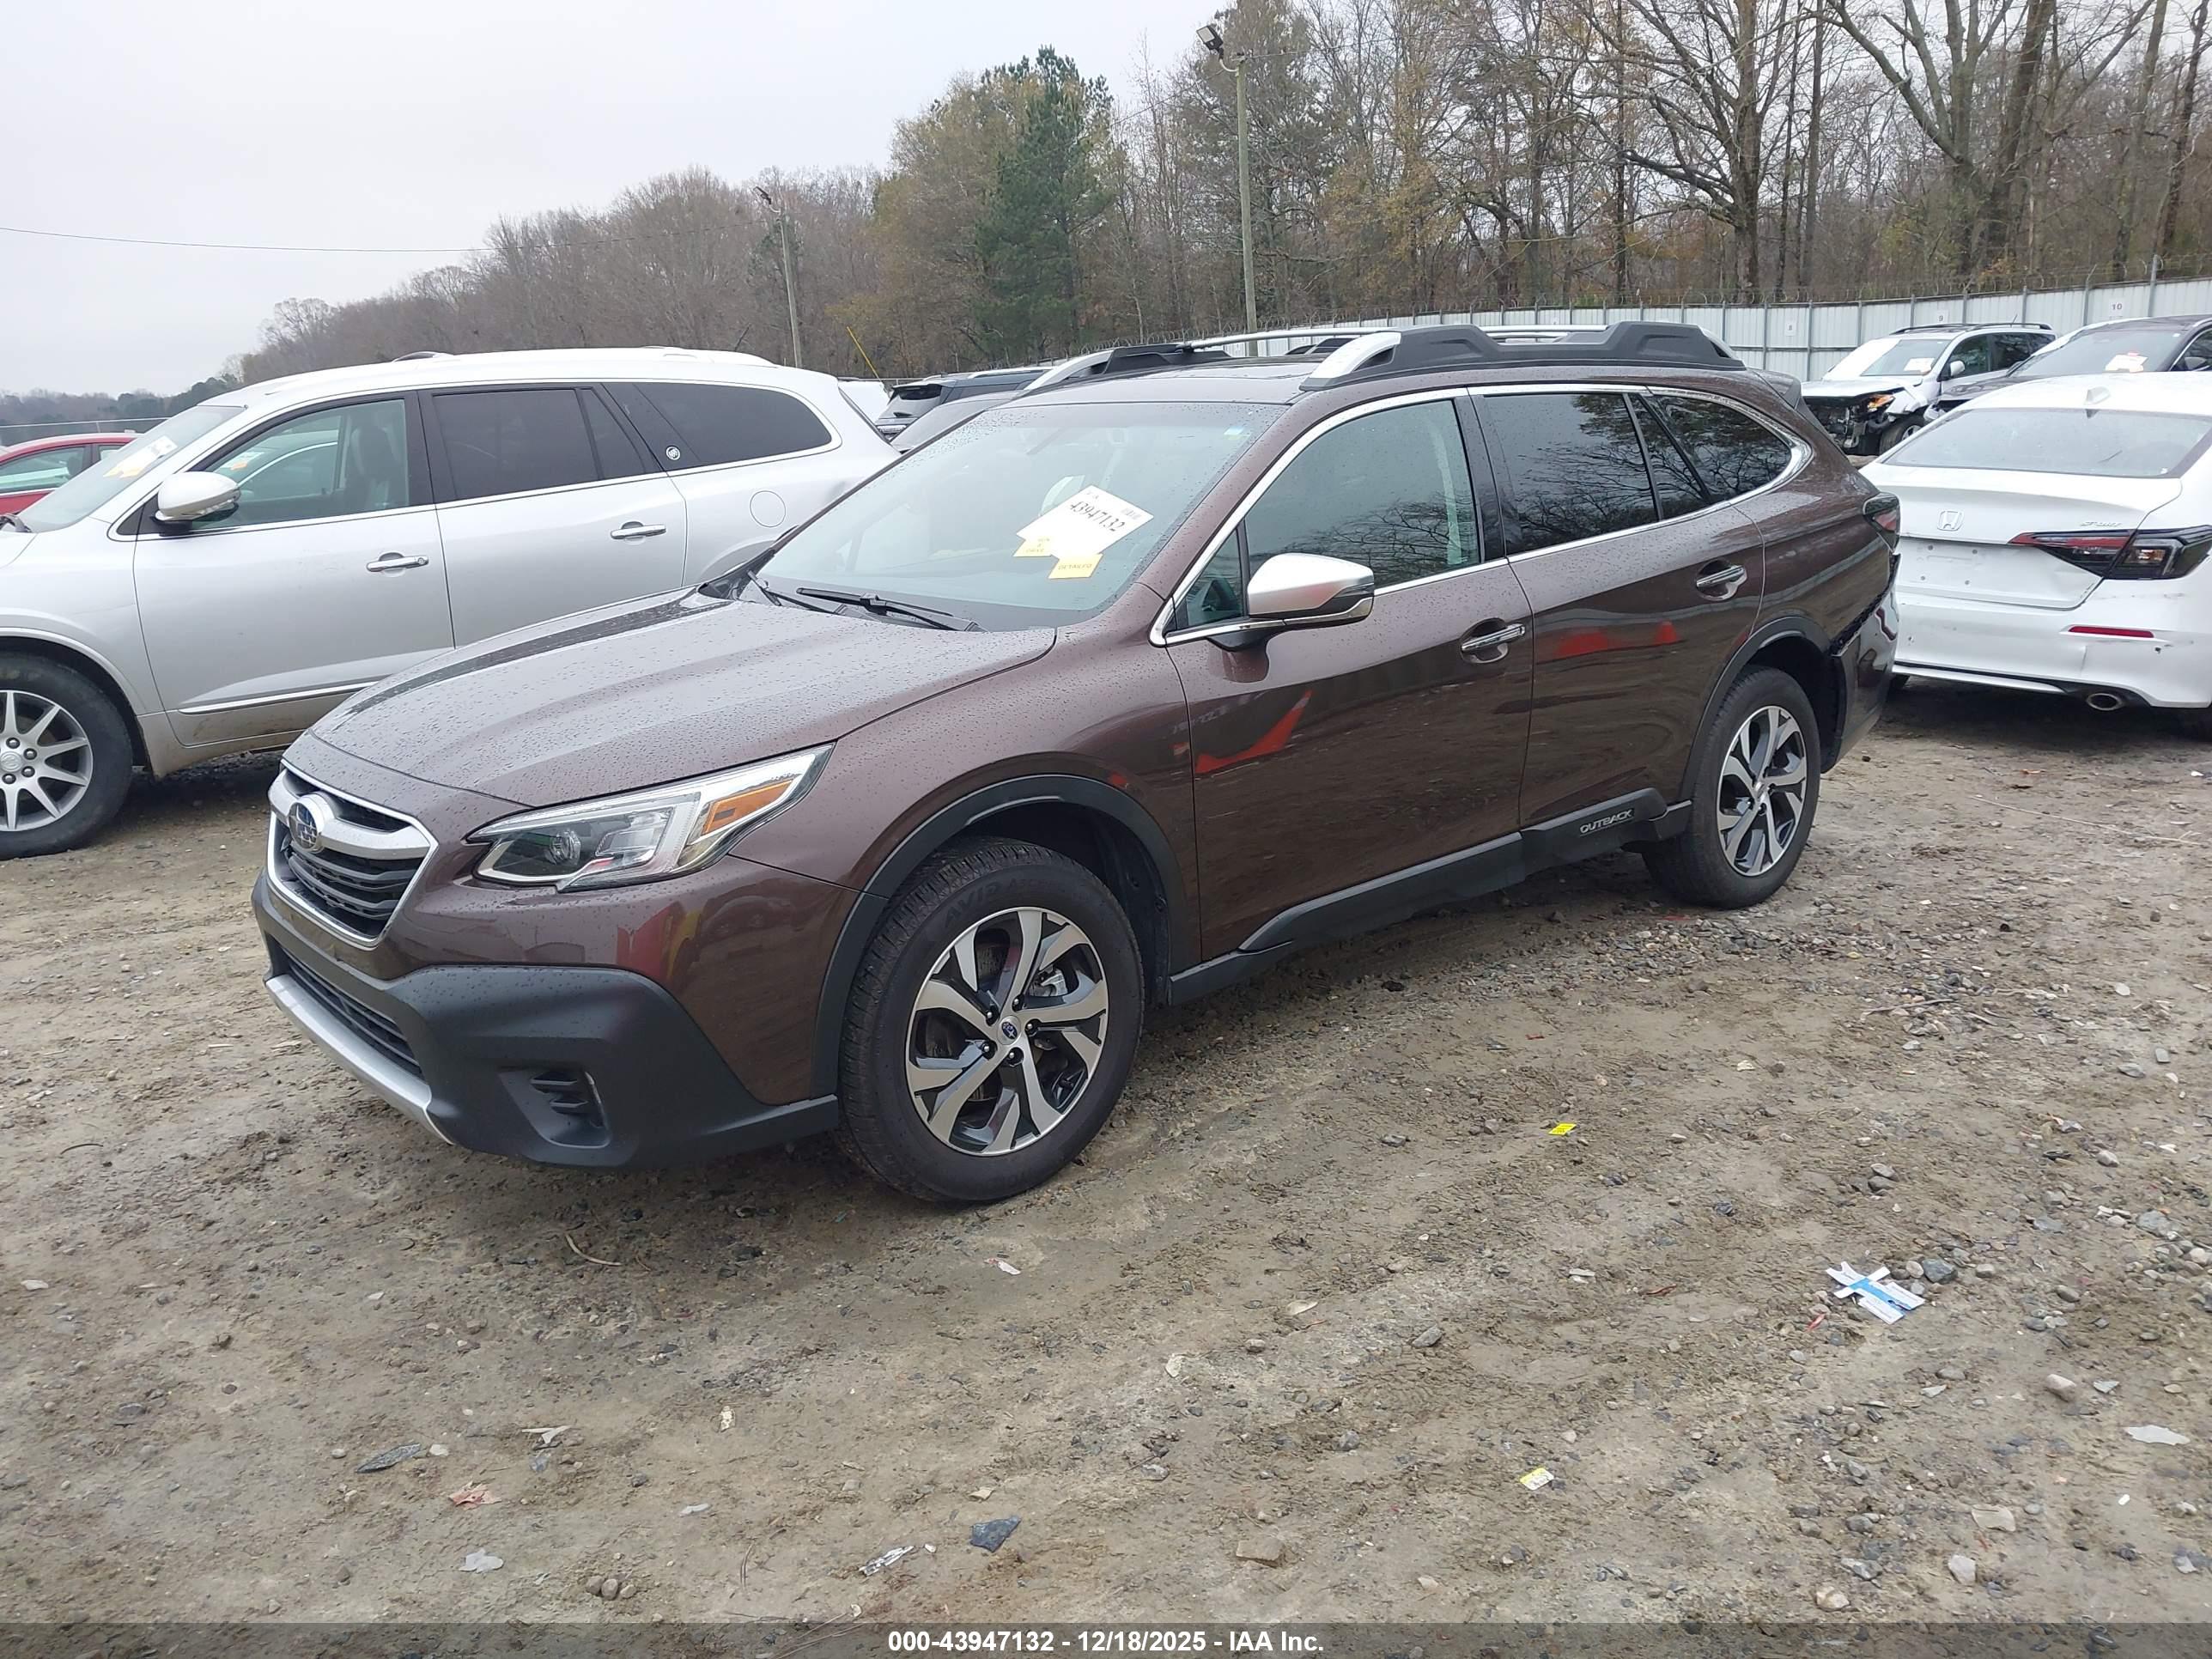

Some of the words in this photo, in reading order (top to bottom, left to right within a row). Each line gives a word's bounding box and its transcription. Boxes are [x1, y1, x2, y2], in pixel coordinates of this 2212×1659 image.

[2112, 302, 2123, 311] 10
[1070, 501, 1126, 532] 43947132
[1579, 810, 1632, 834] OUTBACK
